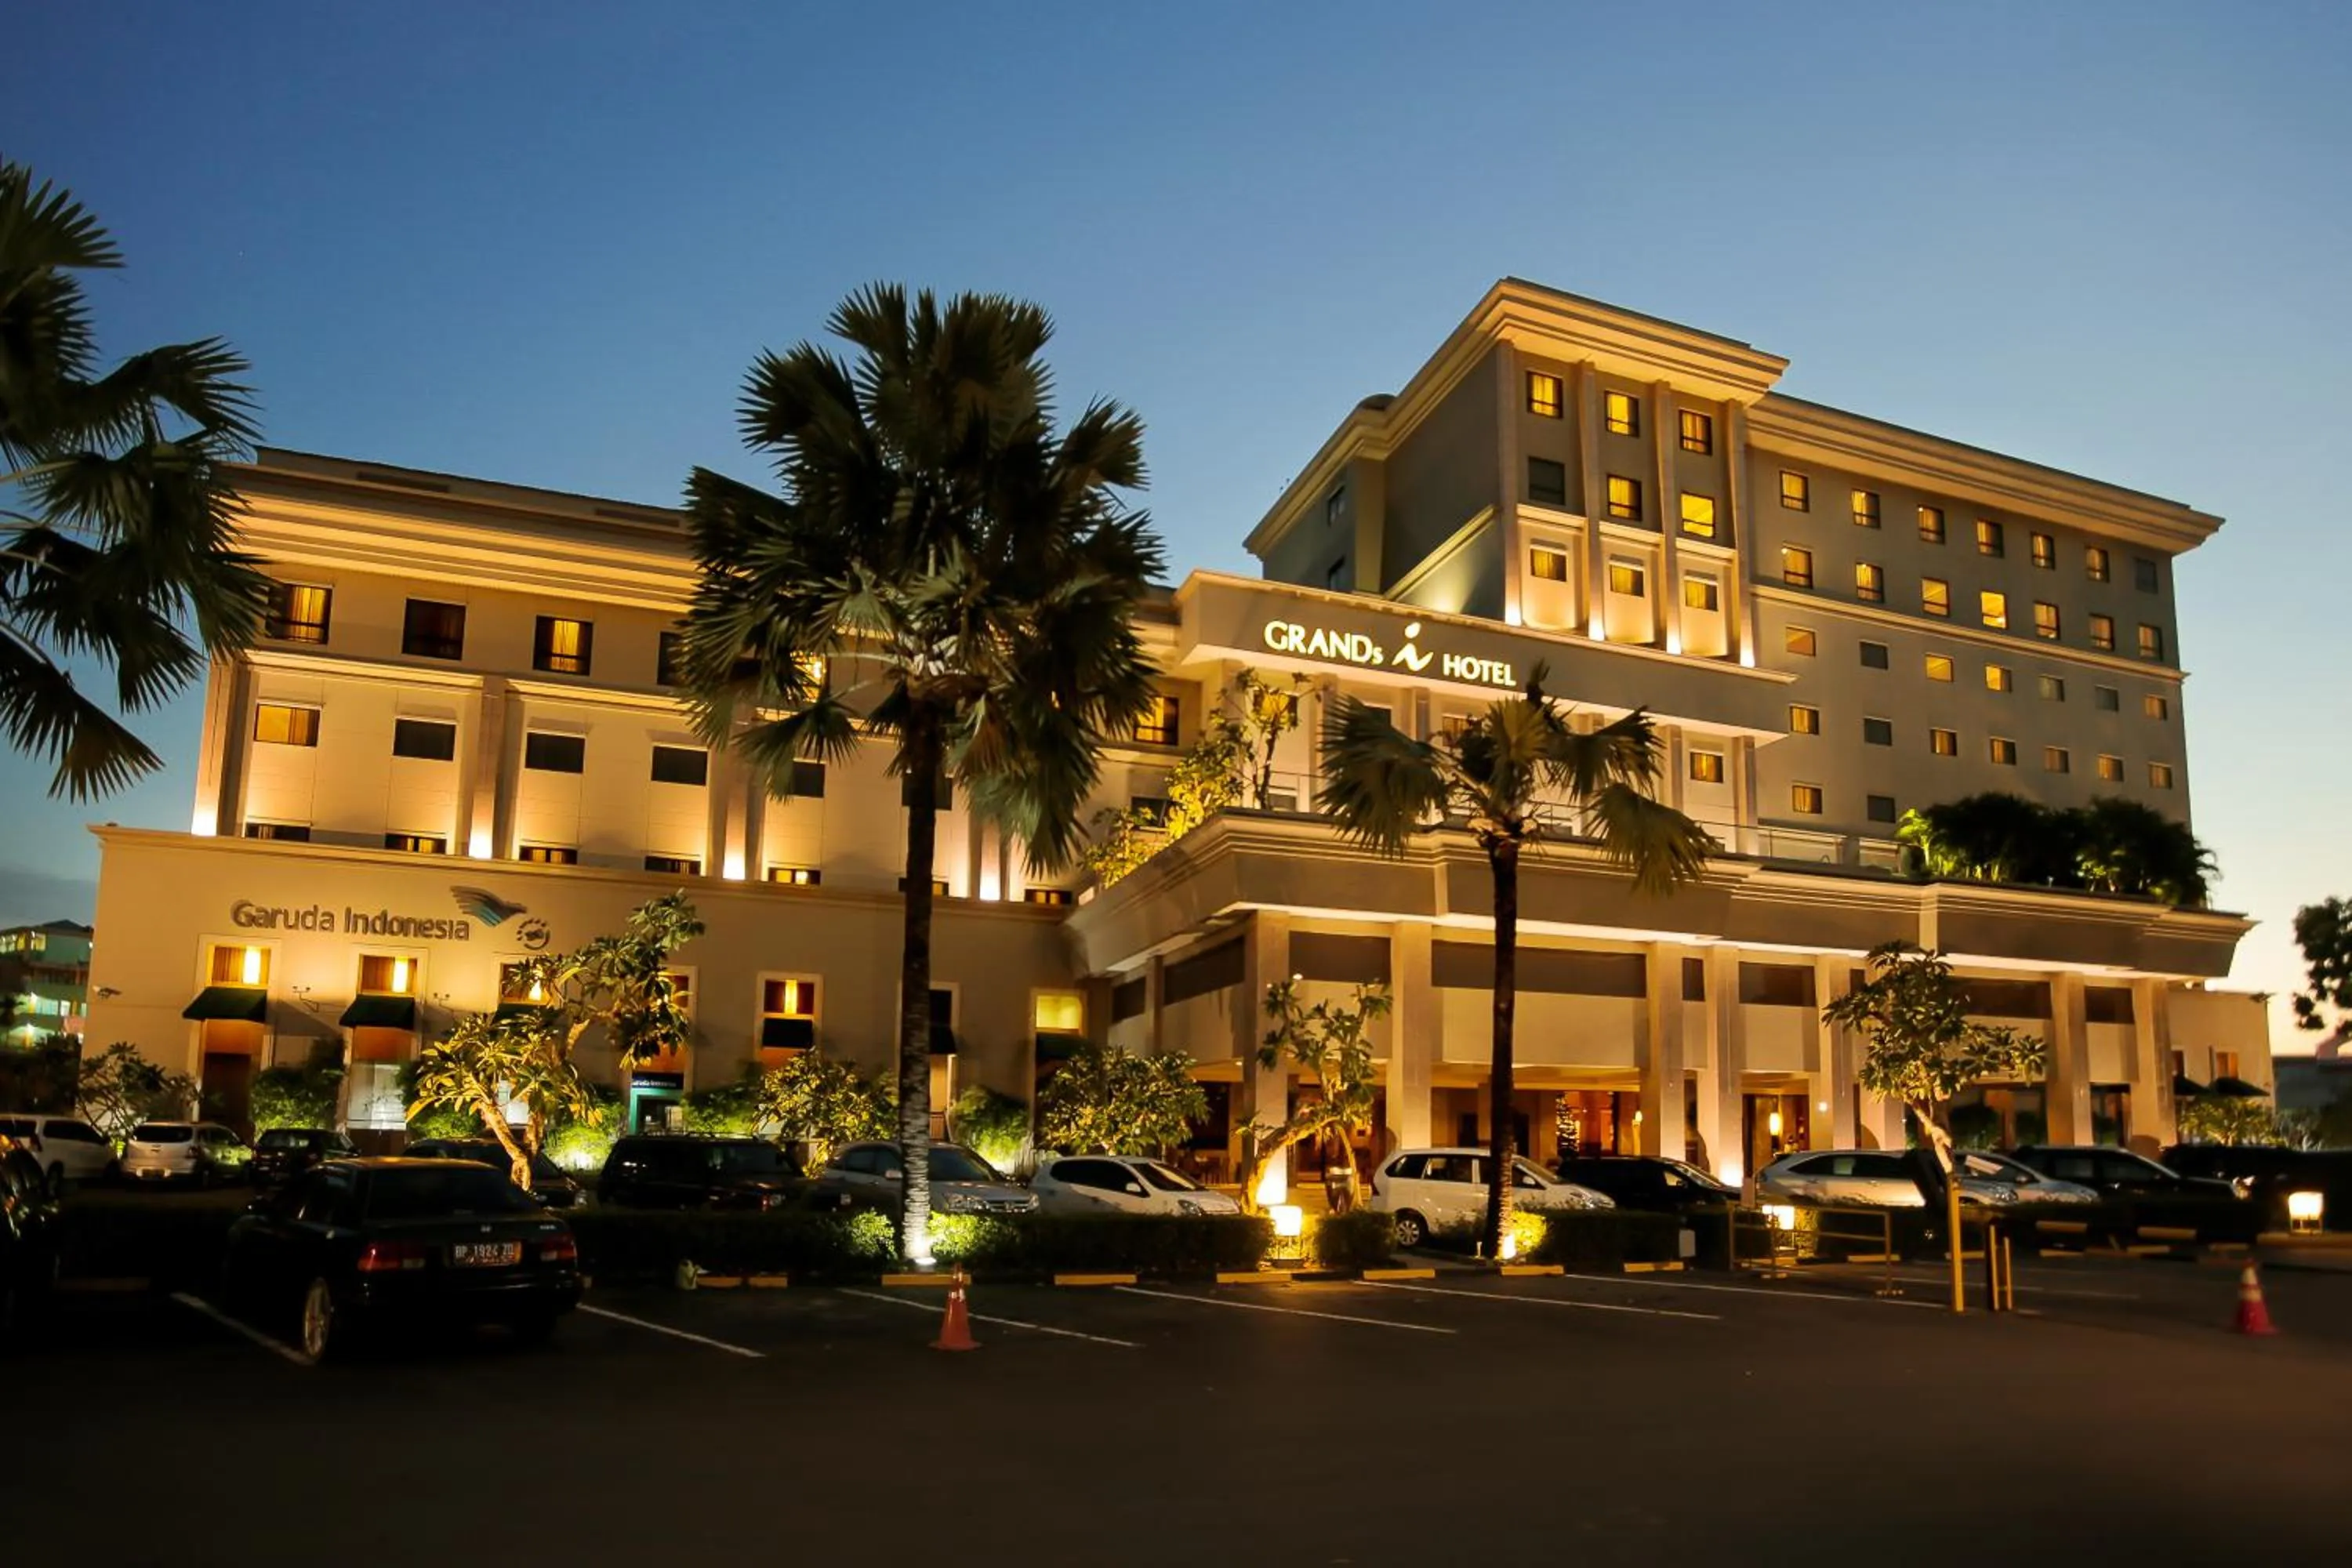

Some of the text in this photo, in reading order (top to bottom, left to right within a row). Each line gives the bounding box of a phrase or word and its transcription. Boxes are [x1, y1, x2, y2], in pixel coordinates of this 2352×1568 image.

[1443, 652, 1516, 687] HOTEL
[230, 898, 470, 941] Garuda Indonesia
